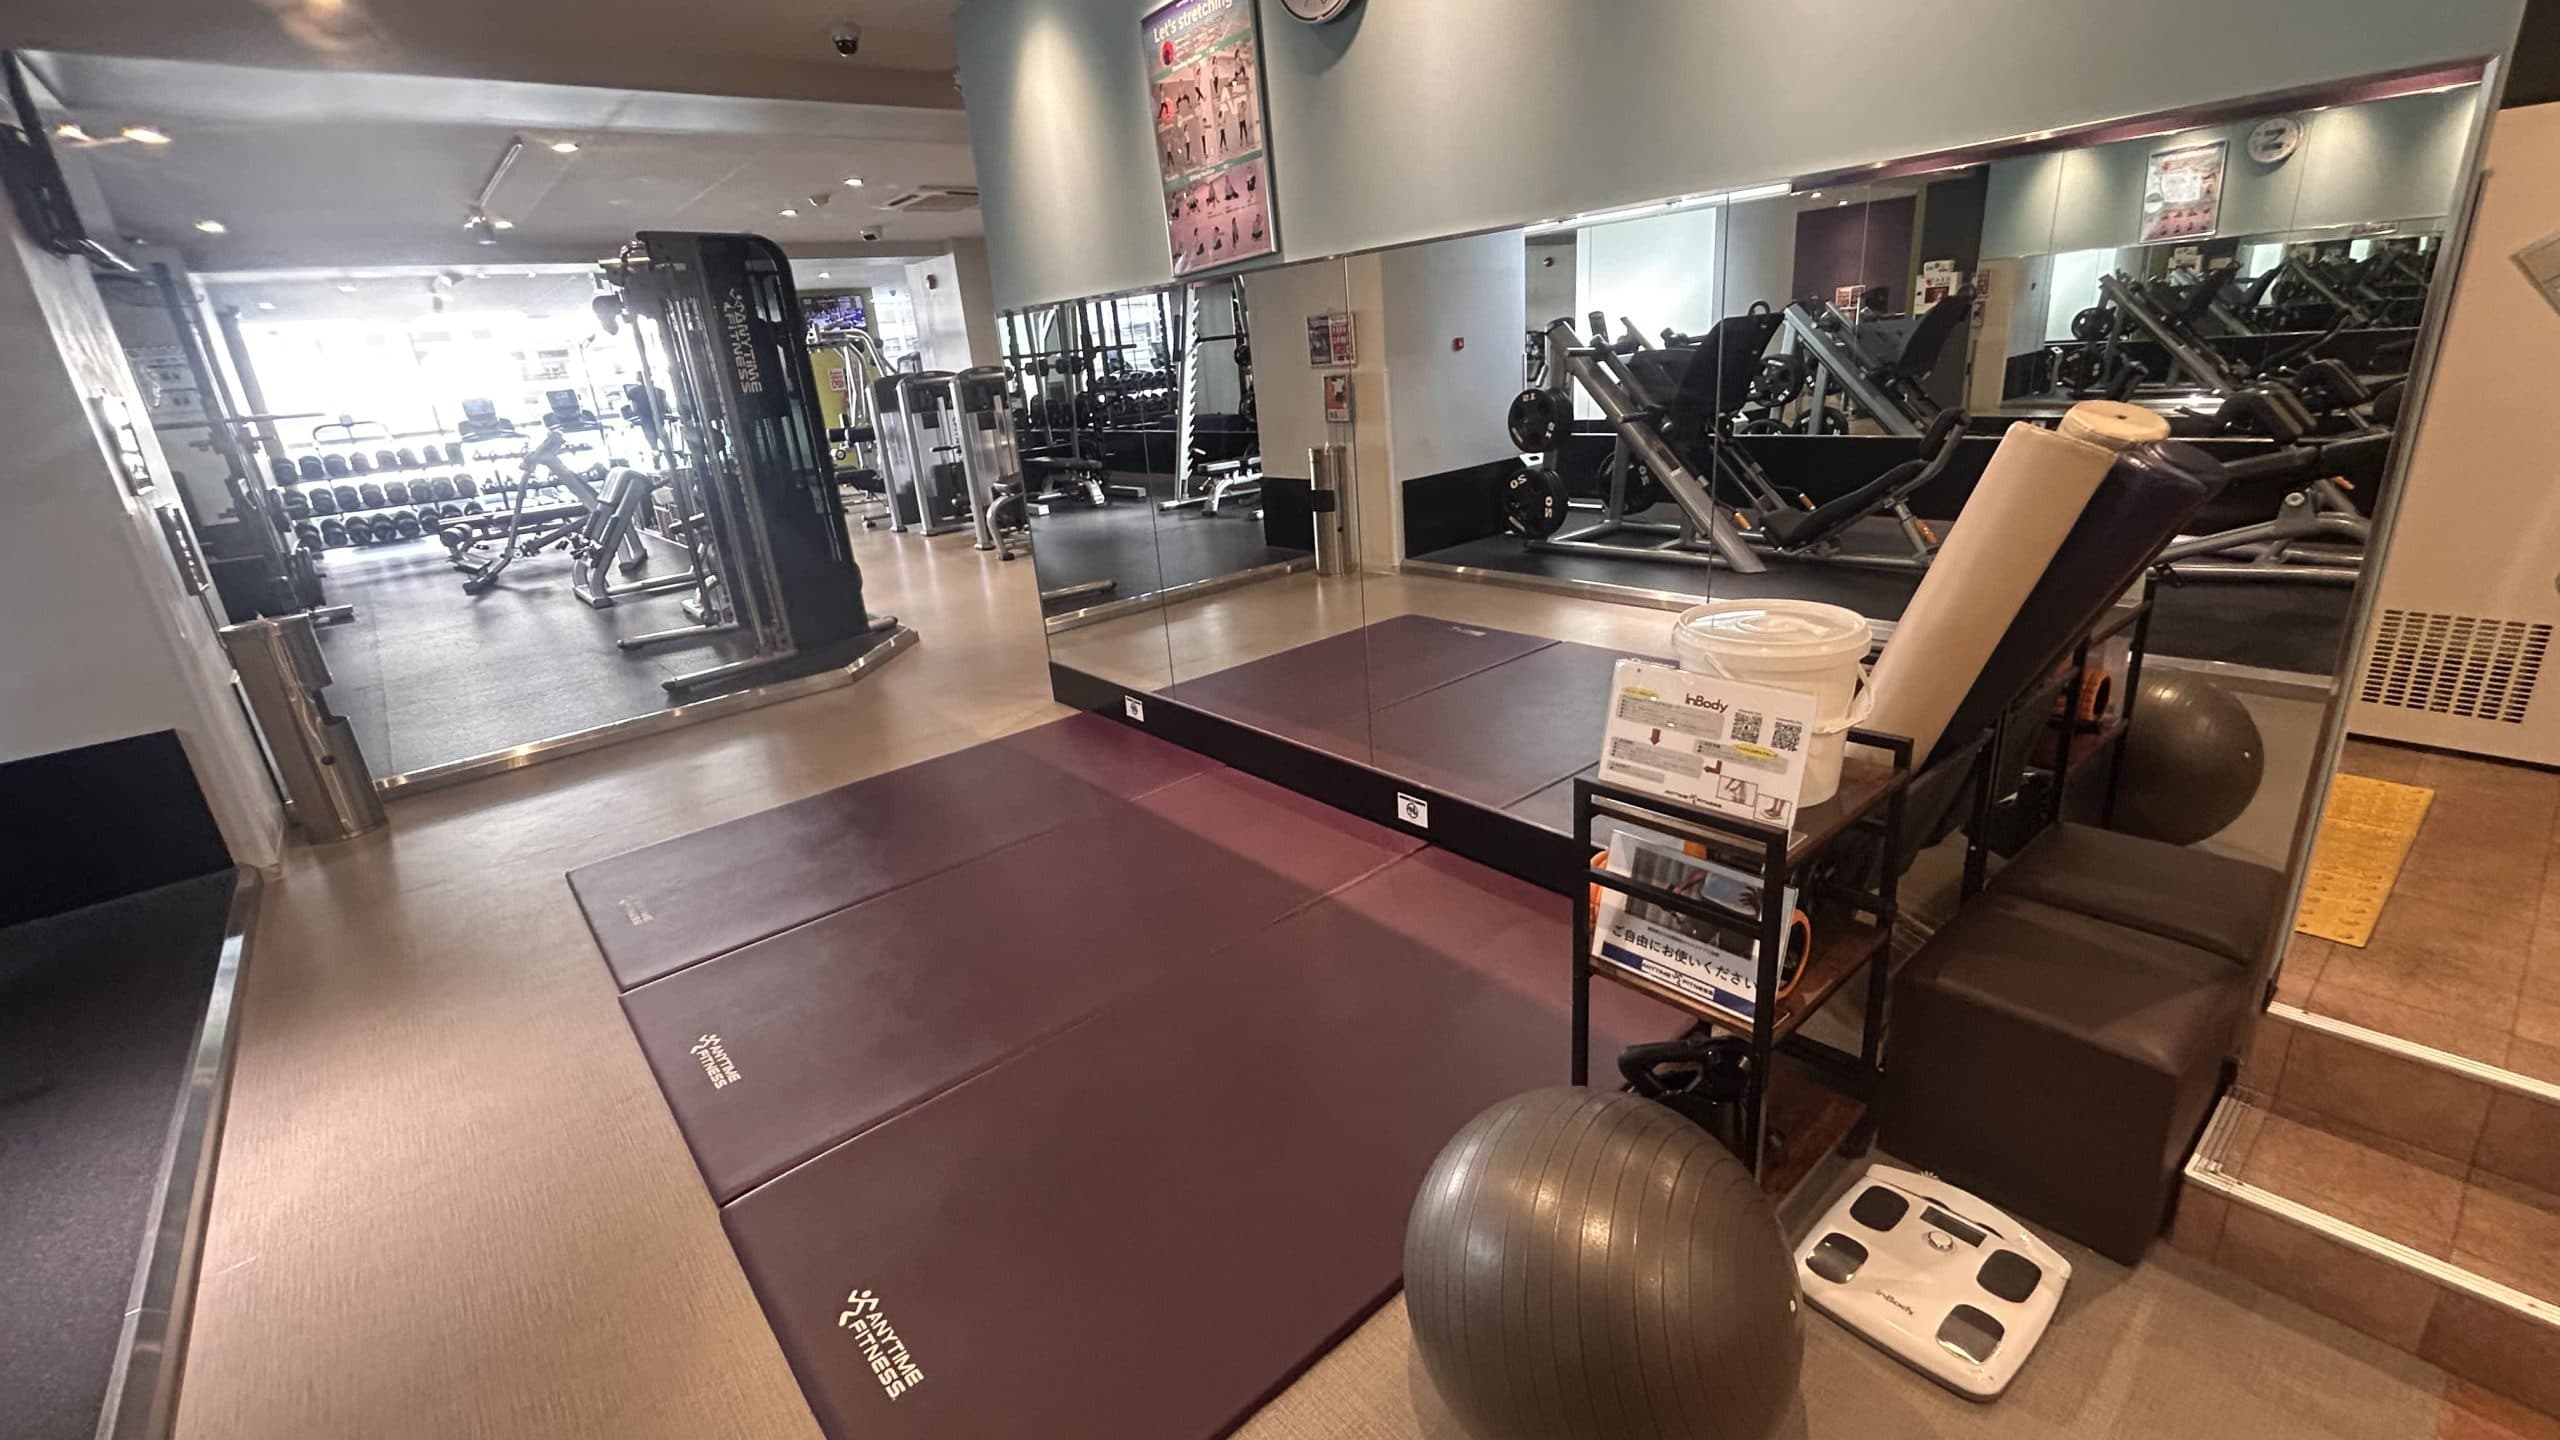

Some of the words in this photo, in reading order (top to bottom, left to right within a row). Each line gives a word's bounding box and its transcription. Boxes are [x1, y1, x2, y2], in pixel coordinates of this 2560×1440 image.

[1153, 19, 1177, 43] Let's
[1178, 0, 1233, 30] stretching
[725, 313, 752, 394] FITNESS
[735, 312, 762, 393] ANYTIME
[1684, 692, 1729, 714] InBody
[1611, 924, 1758, 990] ご自由にお使いください
[696, 1049, 728, 1090] FITNESS
[709, 1045, 741, 1083] ANYTIME
[848, 1319, 907, 1398] FITNESS
[866, 1312, 924, 1388] ANYTIME
